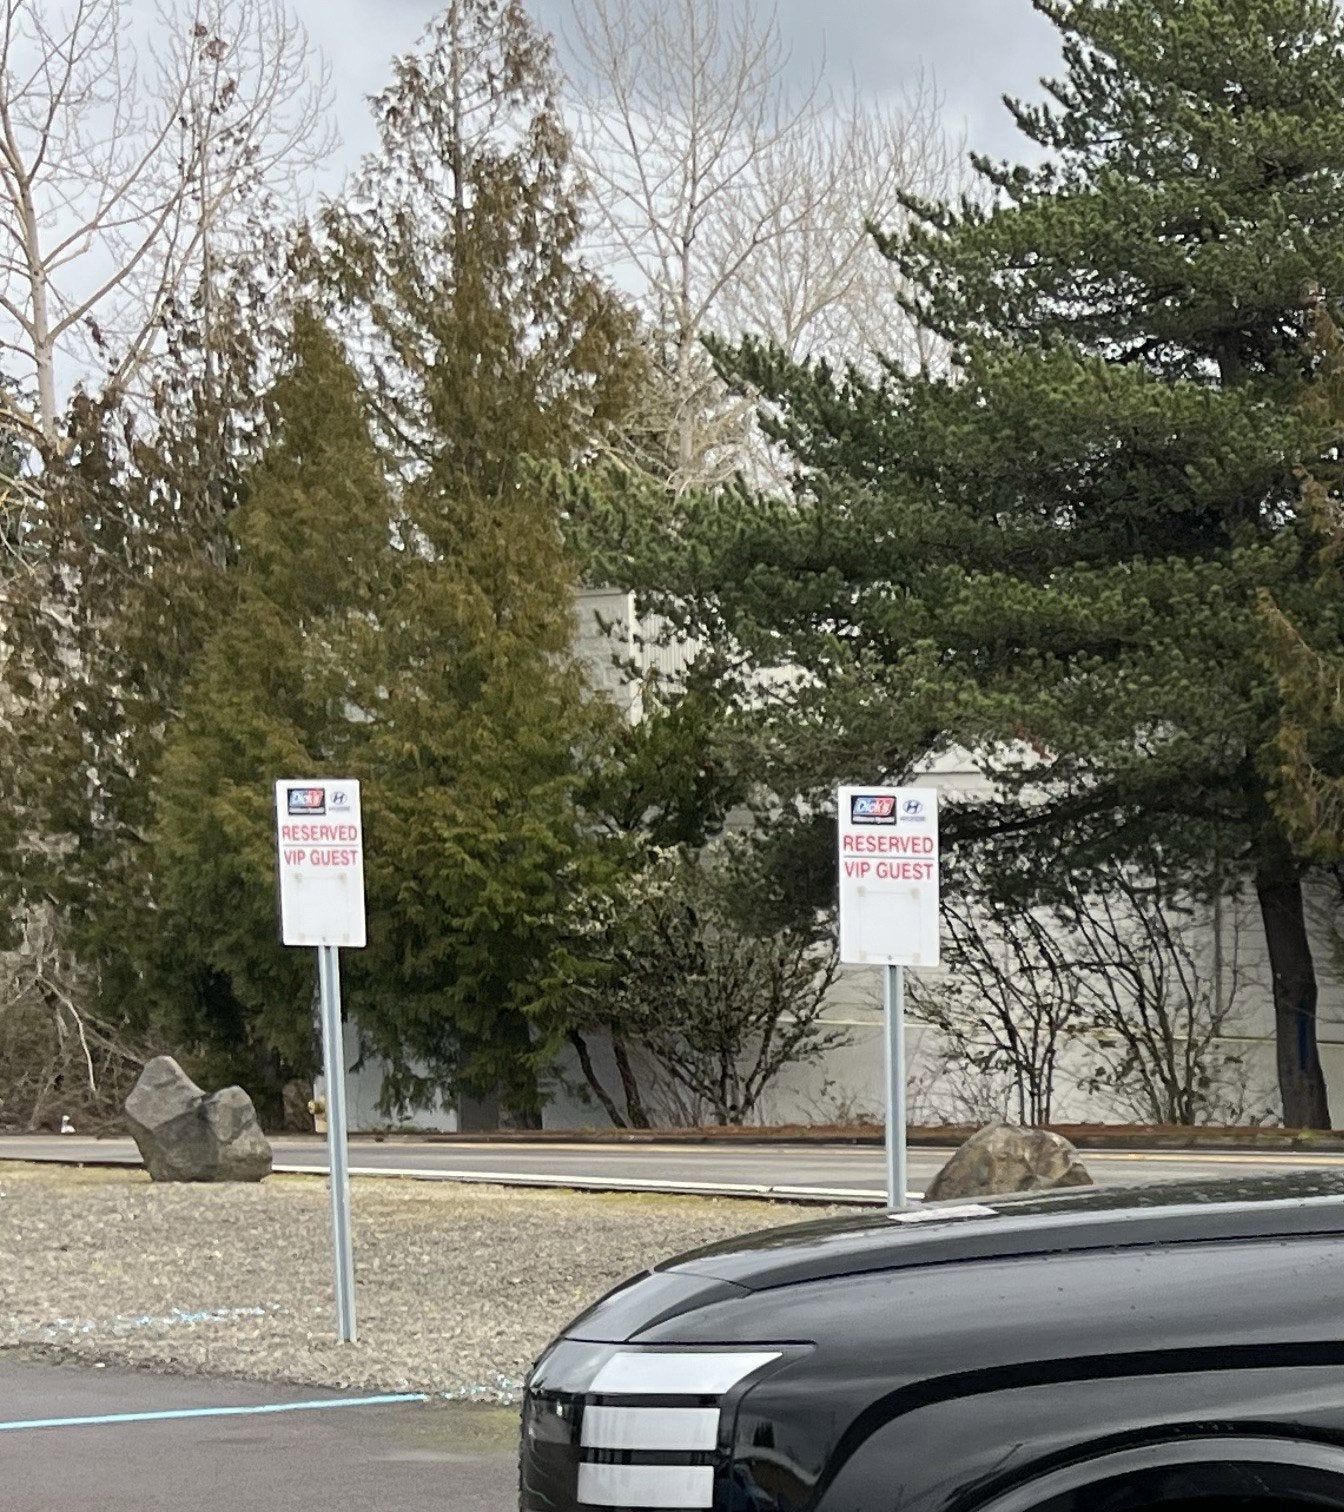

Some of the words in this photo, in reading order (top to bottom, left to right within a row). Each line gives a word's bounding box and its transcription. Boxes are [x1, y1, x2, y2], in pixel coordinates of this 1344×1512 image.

[282, 825, 358, 841] RESERVED
[843, 835, 934, 853] RESERVED
[284, 850, 306, 865] VIP
[310, 850, 358, 866] GUEST
[844, 862, 870, 878] VIP
[876, 862, 934, 879] GUEST
